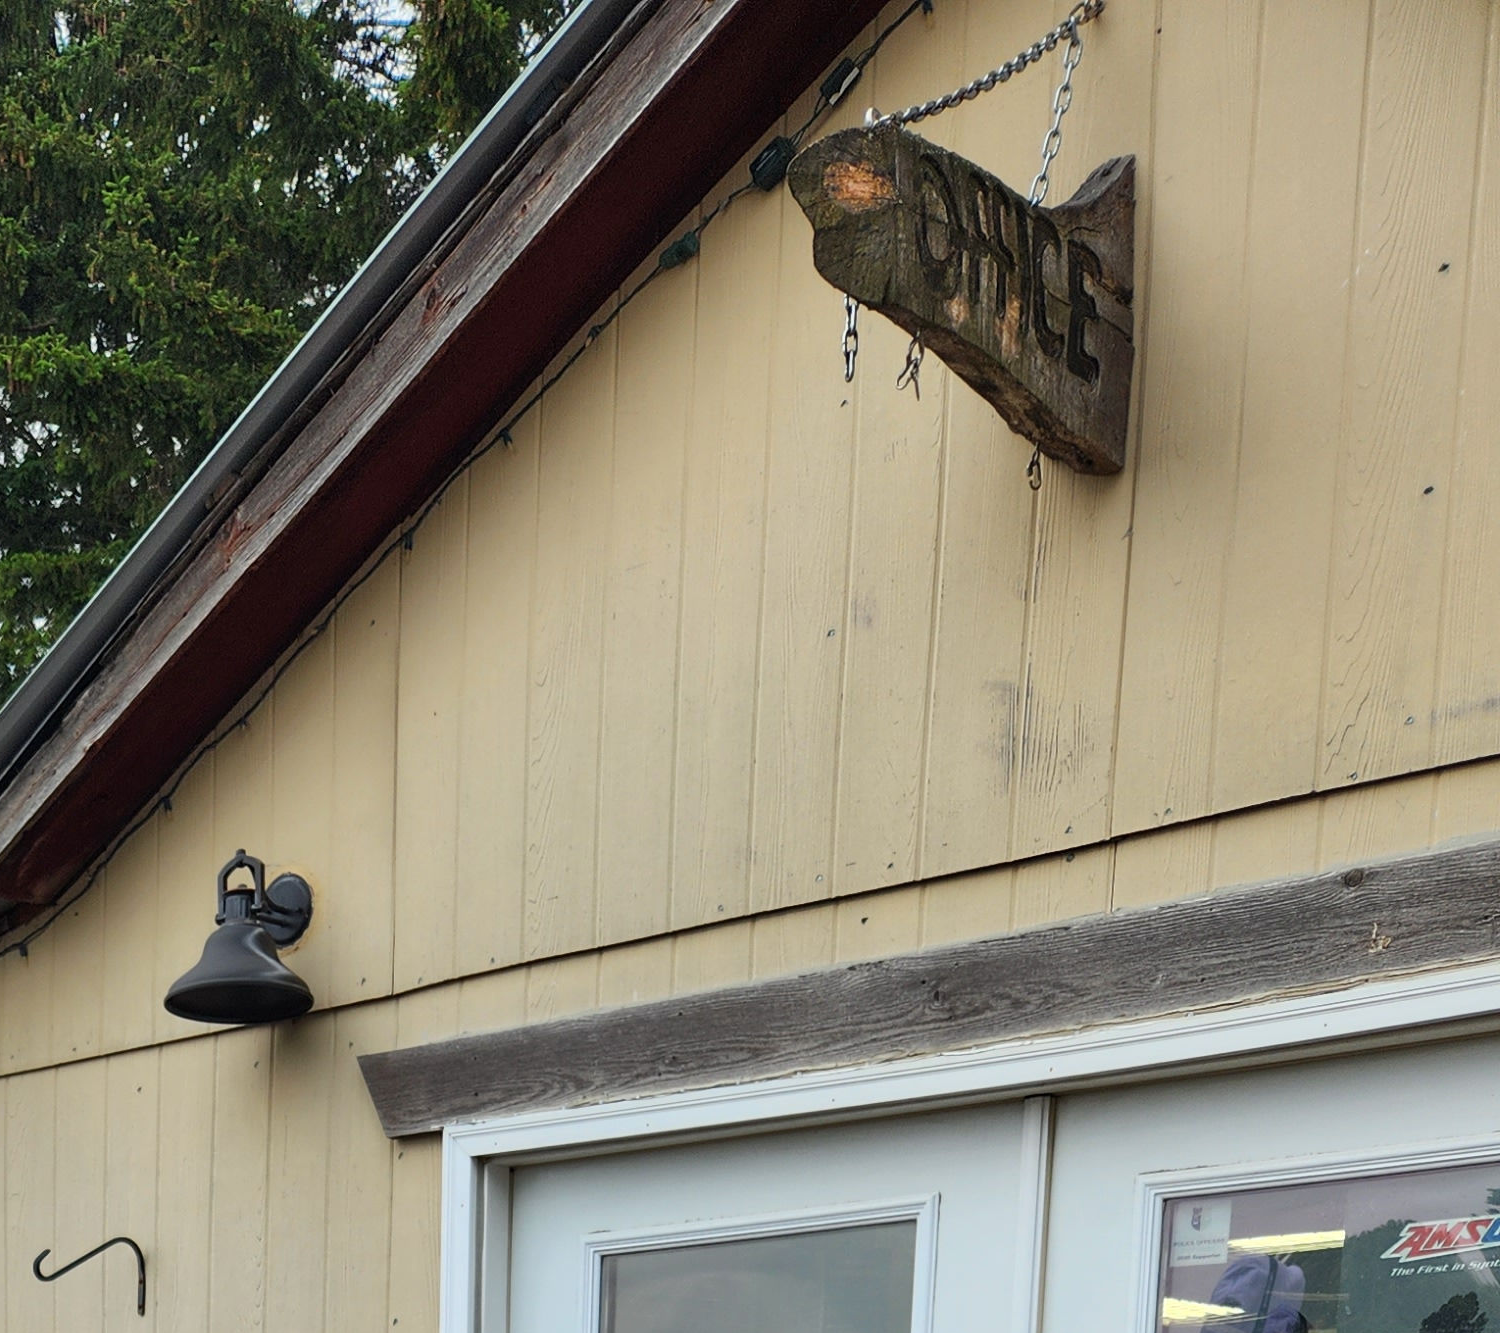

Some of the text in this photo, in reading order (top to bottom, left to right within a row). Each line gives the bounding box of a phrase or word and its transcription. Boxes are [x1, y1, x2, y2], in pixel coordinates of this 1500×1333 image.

[1390, 1262, 1466, 1277] The First in
